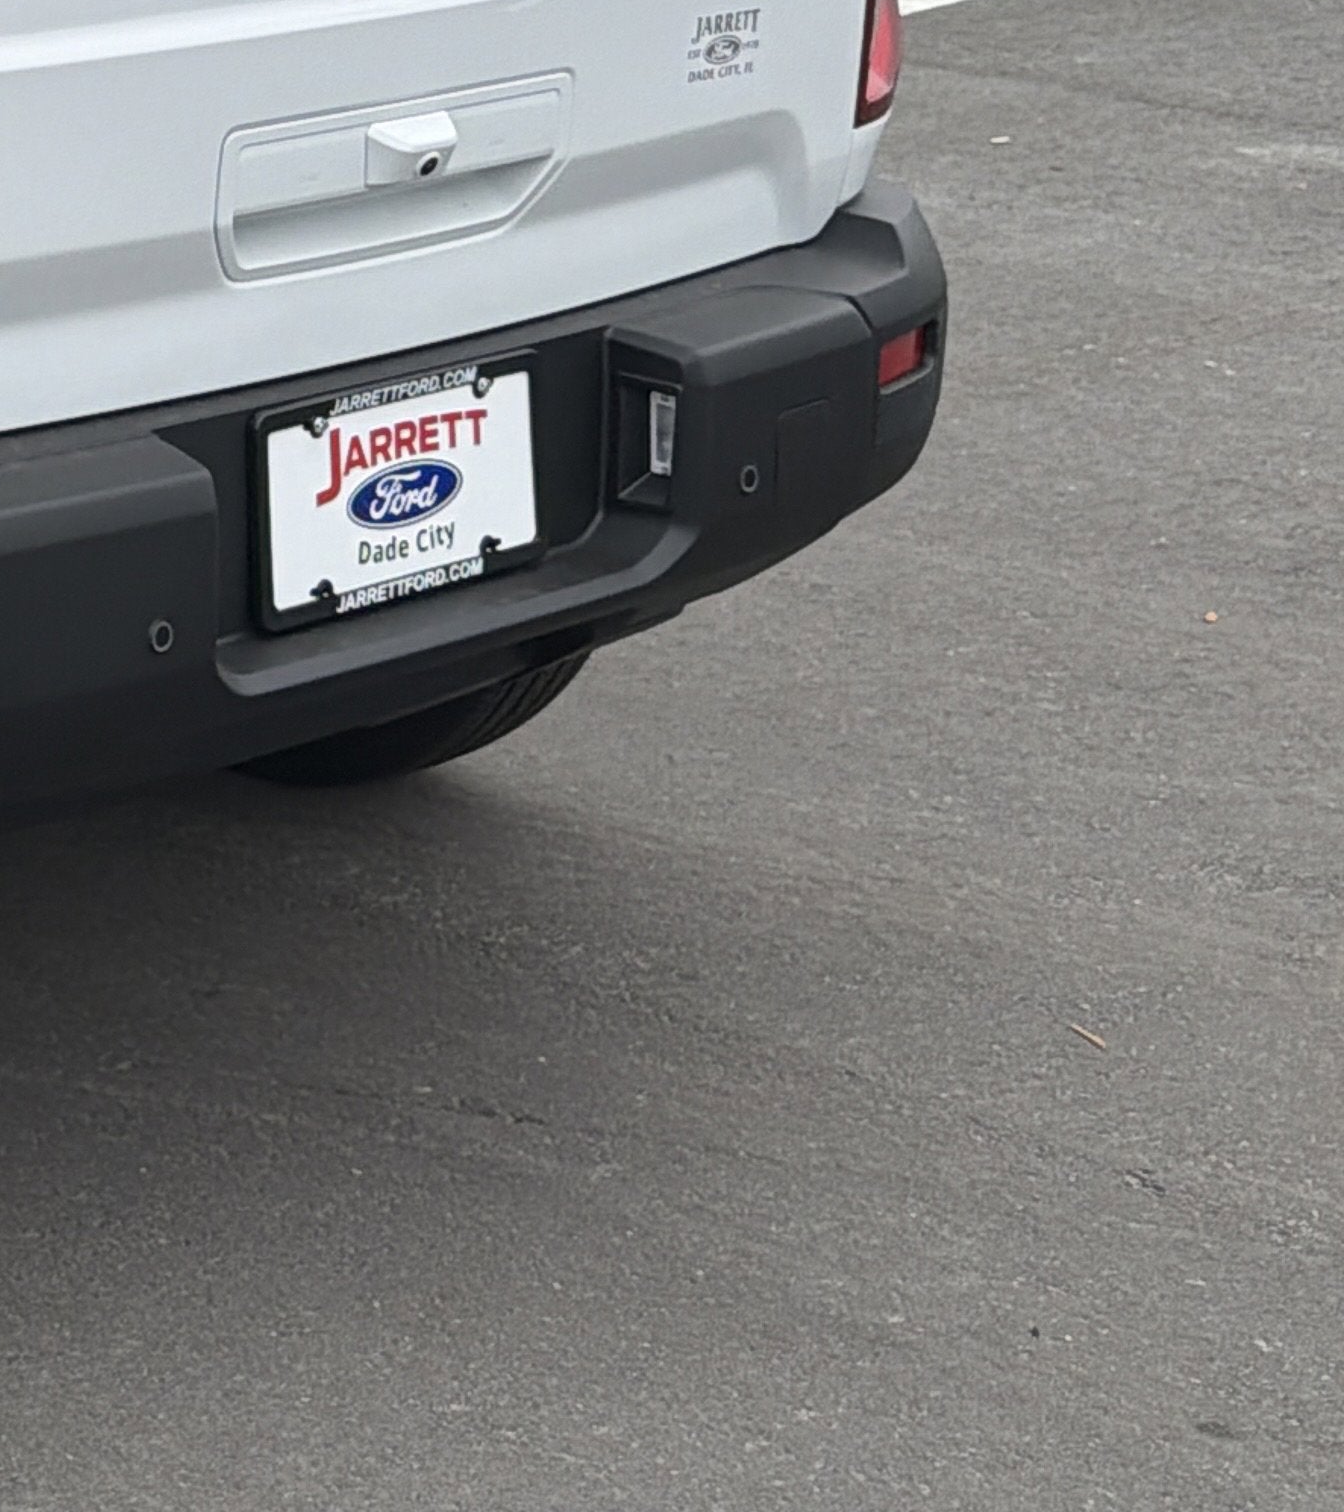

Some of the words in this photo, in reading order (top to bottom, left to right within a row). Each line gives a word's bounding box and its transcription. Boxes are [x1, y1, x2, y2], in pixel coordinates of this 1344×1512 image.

[691, 8, 761, 45] JARRETT
[329, 365, 478, 416] JARRETTFORD.COM
[316, 409, 488, 507] JARRETT
[369, 469, 439, 520] Ford
[358, 536, 410, 565] Dade
[417, 521, 455, 553] City
[335, 556, 484, 614] JARRETTFORD.COM
